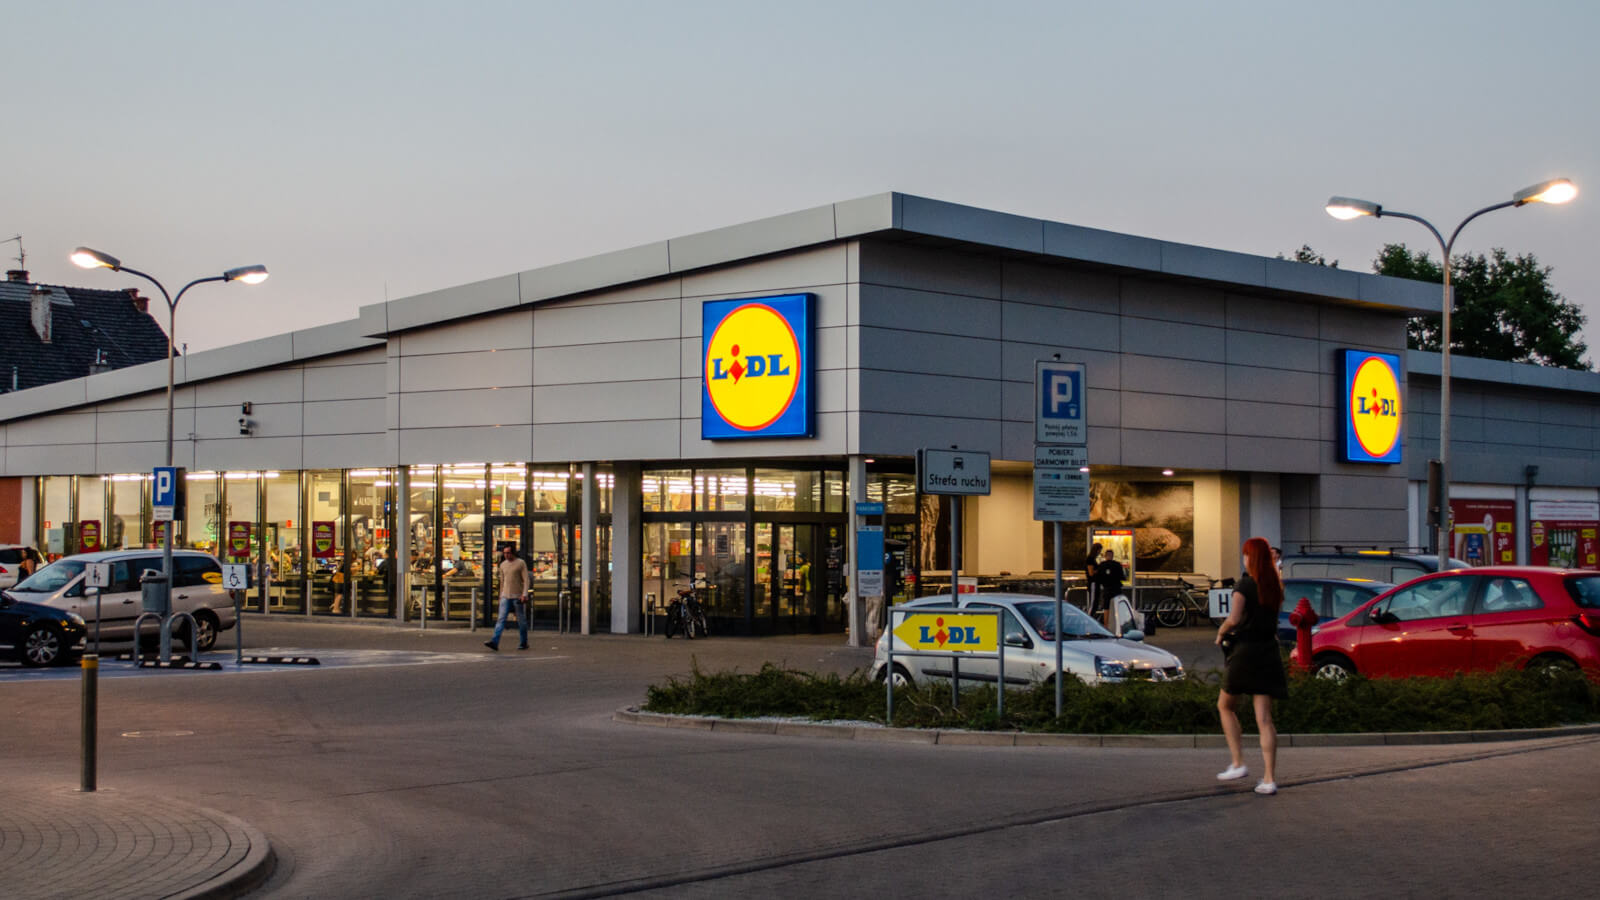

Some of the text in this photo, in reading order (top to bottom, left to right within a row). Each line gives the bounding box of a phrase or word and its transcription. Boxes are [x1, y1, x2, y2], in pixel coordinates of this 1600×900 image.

[1051, 375, 1072, 413] P
[1048, 448, 1074, 456] POBIERZ
[157, 471, 171, 502] P
[929, 473, 986, 487] Strefa ruchu
[1218, 593, 1229, 613] H
